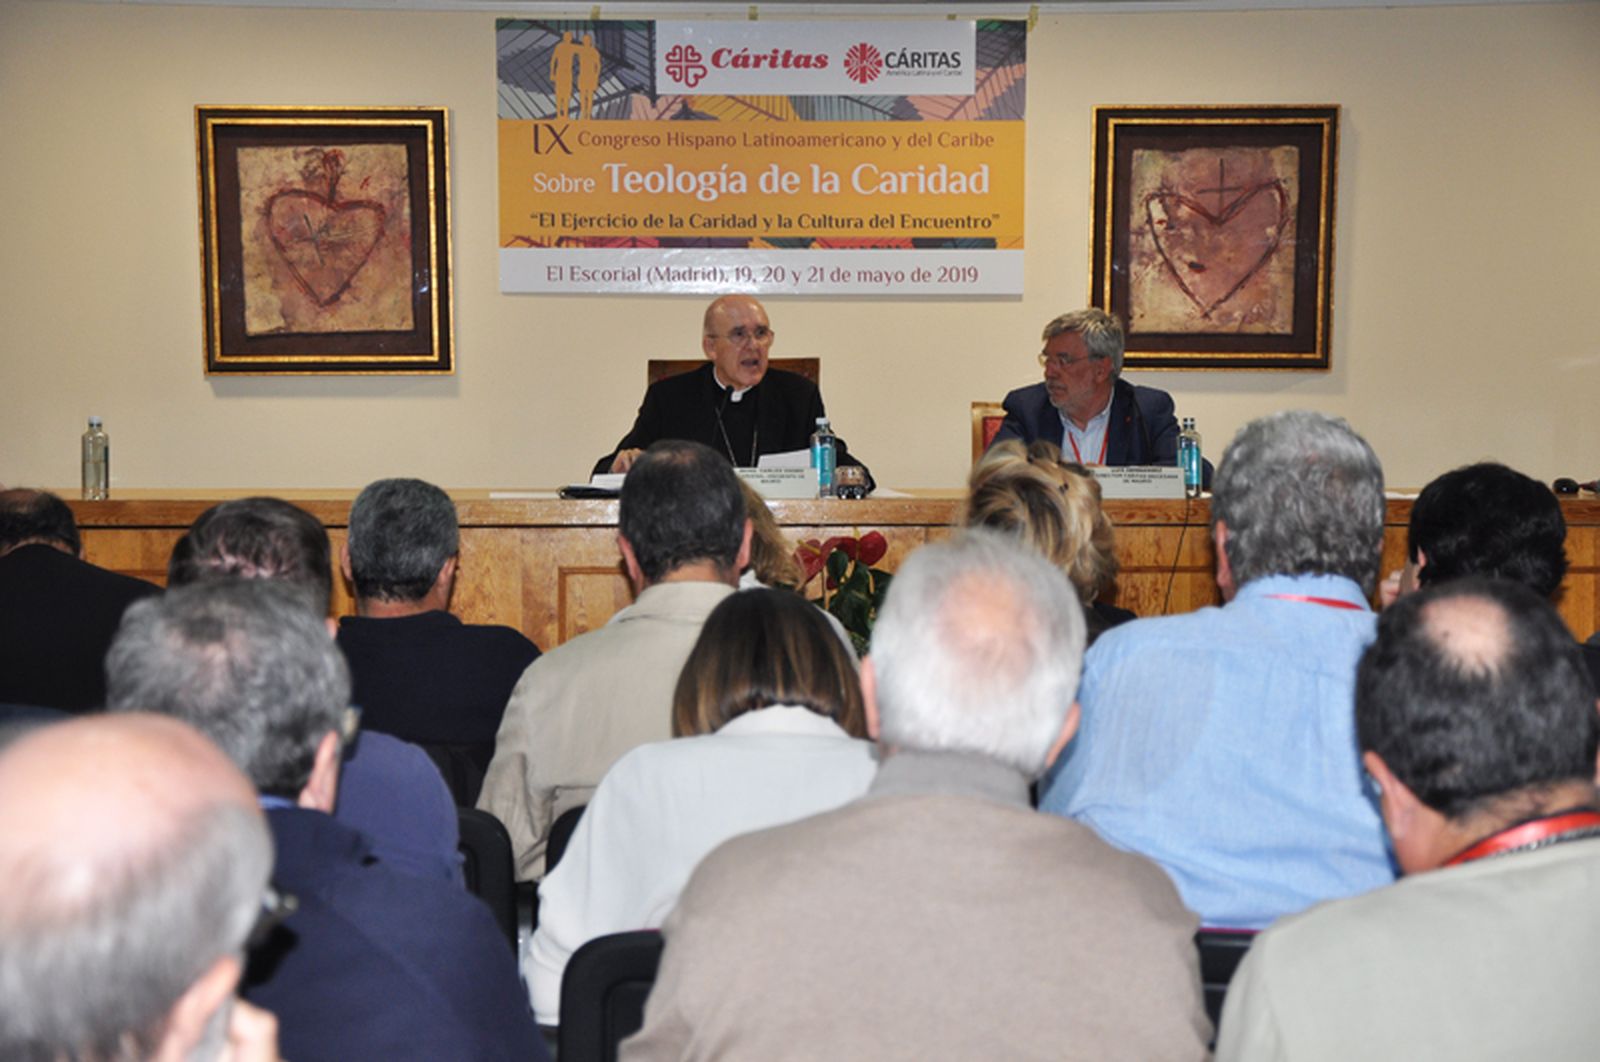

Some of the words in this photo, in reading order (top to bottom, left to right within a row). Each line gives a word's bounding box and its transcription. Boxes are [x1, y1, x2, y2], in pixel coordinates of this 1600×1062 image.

[711, 48, 829, 69] Cáritas
[885, 47, 961, 68] CÁRITAS
[533, 123, 573, 154] IX
[578, 131, 661, 150] Congreso
[666, 131, 737, 149] Hispano
[743, 131, 887, 148] Latinoamericano
[892, 134, 901, 151] y
[907, 132, 932, 148] del
[937, 132, 995, 148] Caribe
[533, 172, 596, 193] Sobre
[602, 163, 747, 201] Teología
[759, 163, 800, 194] de
[809, 163, 840, 194] la
[851, 163, 990, 195] Caridad
[561, 212, 638, 231] Ejercicio
[643, 213, 664, 229] de
[669, 213, 684, 229] la
[689, 213, 757, 229] Caridad
[762, 216, 772, 232] y
[777, 213, 793, 229] la
[797, 213, 864, 229] Cultura
[869, 213, 895, 229] del
[546, 266, 563, 282] El
[570, 266, 641, 282] Escorial
[647, 266, 729, 284] (Madrid),
[735, 266, 757, 284] 19,
[762, 266, 785, 283] 20
[791, 270, 801, 286] y
[807, 266, 825, 283] 21
[830, 266, 851, 283] de
[857, 269, 905, 286] mayo
[910, 266, 932, 283] de
[937, 266, 979, 283] 2019
